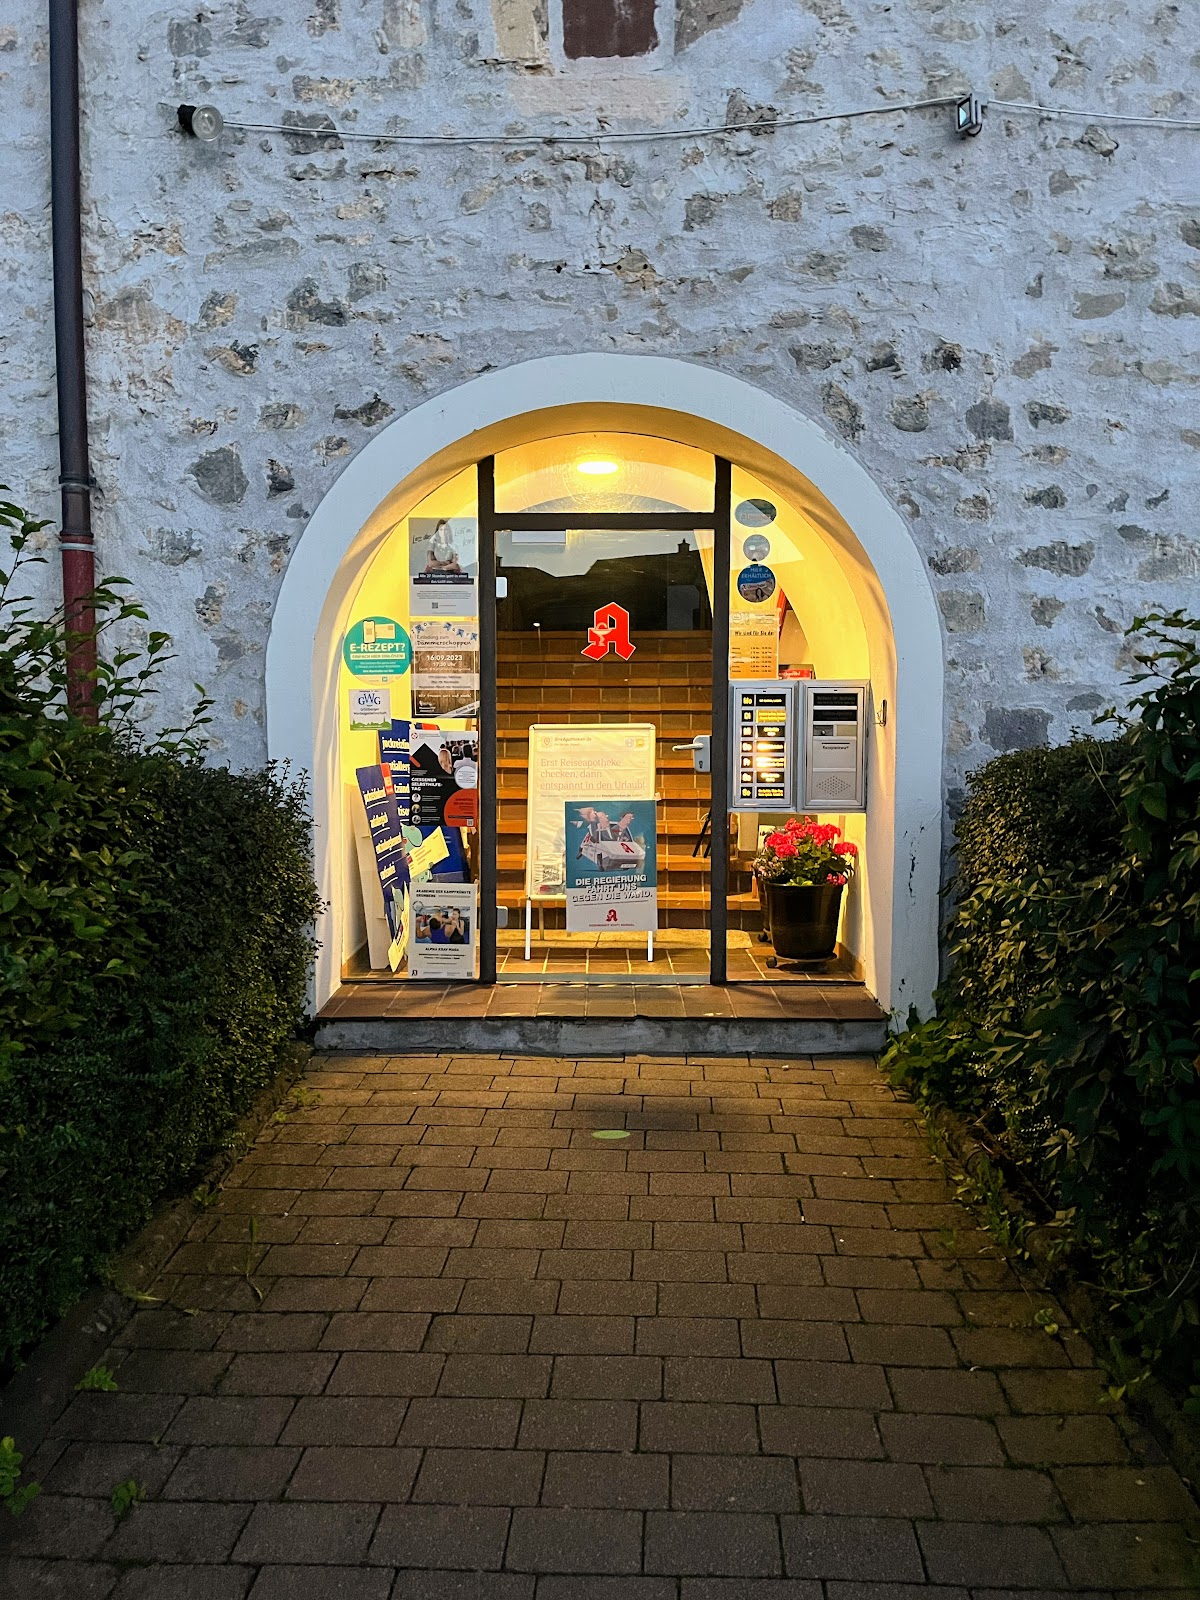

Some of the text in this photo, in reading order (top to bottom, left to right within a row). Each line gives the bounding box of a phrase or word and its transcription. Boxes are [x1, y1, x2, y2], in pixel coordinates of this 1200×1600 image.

[350, 642, 406, 652] E-REZEPT?
[358, 692, 381, 705] GWG
[541, 758, 622, 770] Erst Reiseapotheke
[540, 769, 603, 779] checken, dann
[540, 780, 645, 791] entspannt in den Urlaub!
[575, 874, 647, 886] DIE REGIERUNG
[585, 882, 638, 893] FÄHRT UNS
[572, 890, 653, 902] GEGEN DIE WAND.
